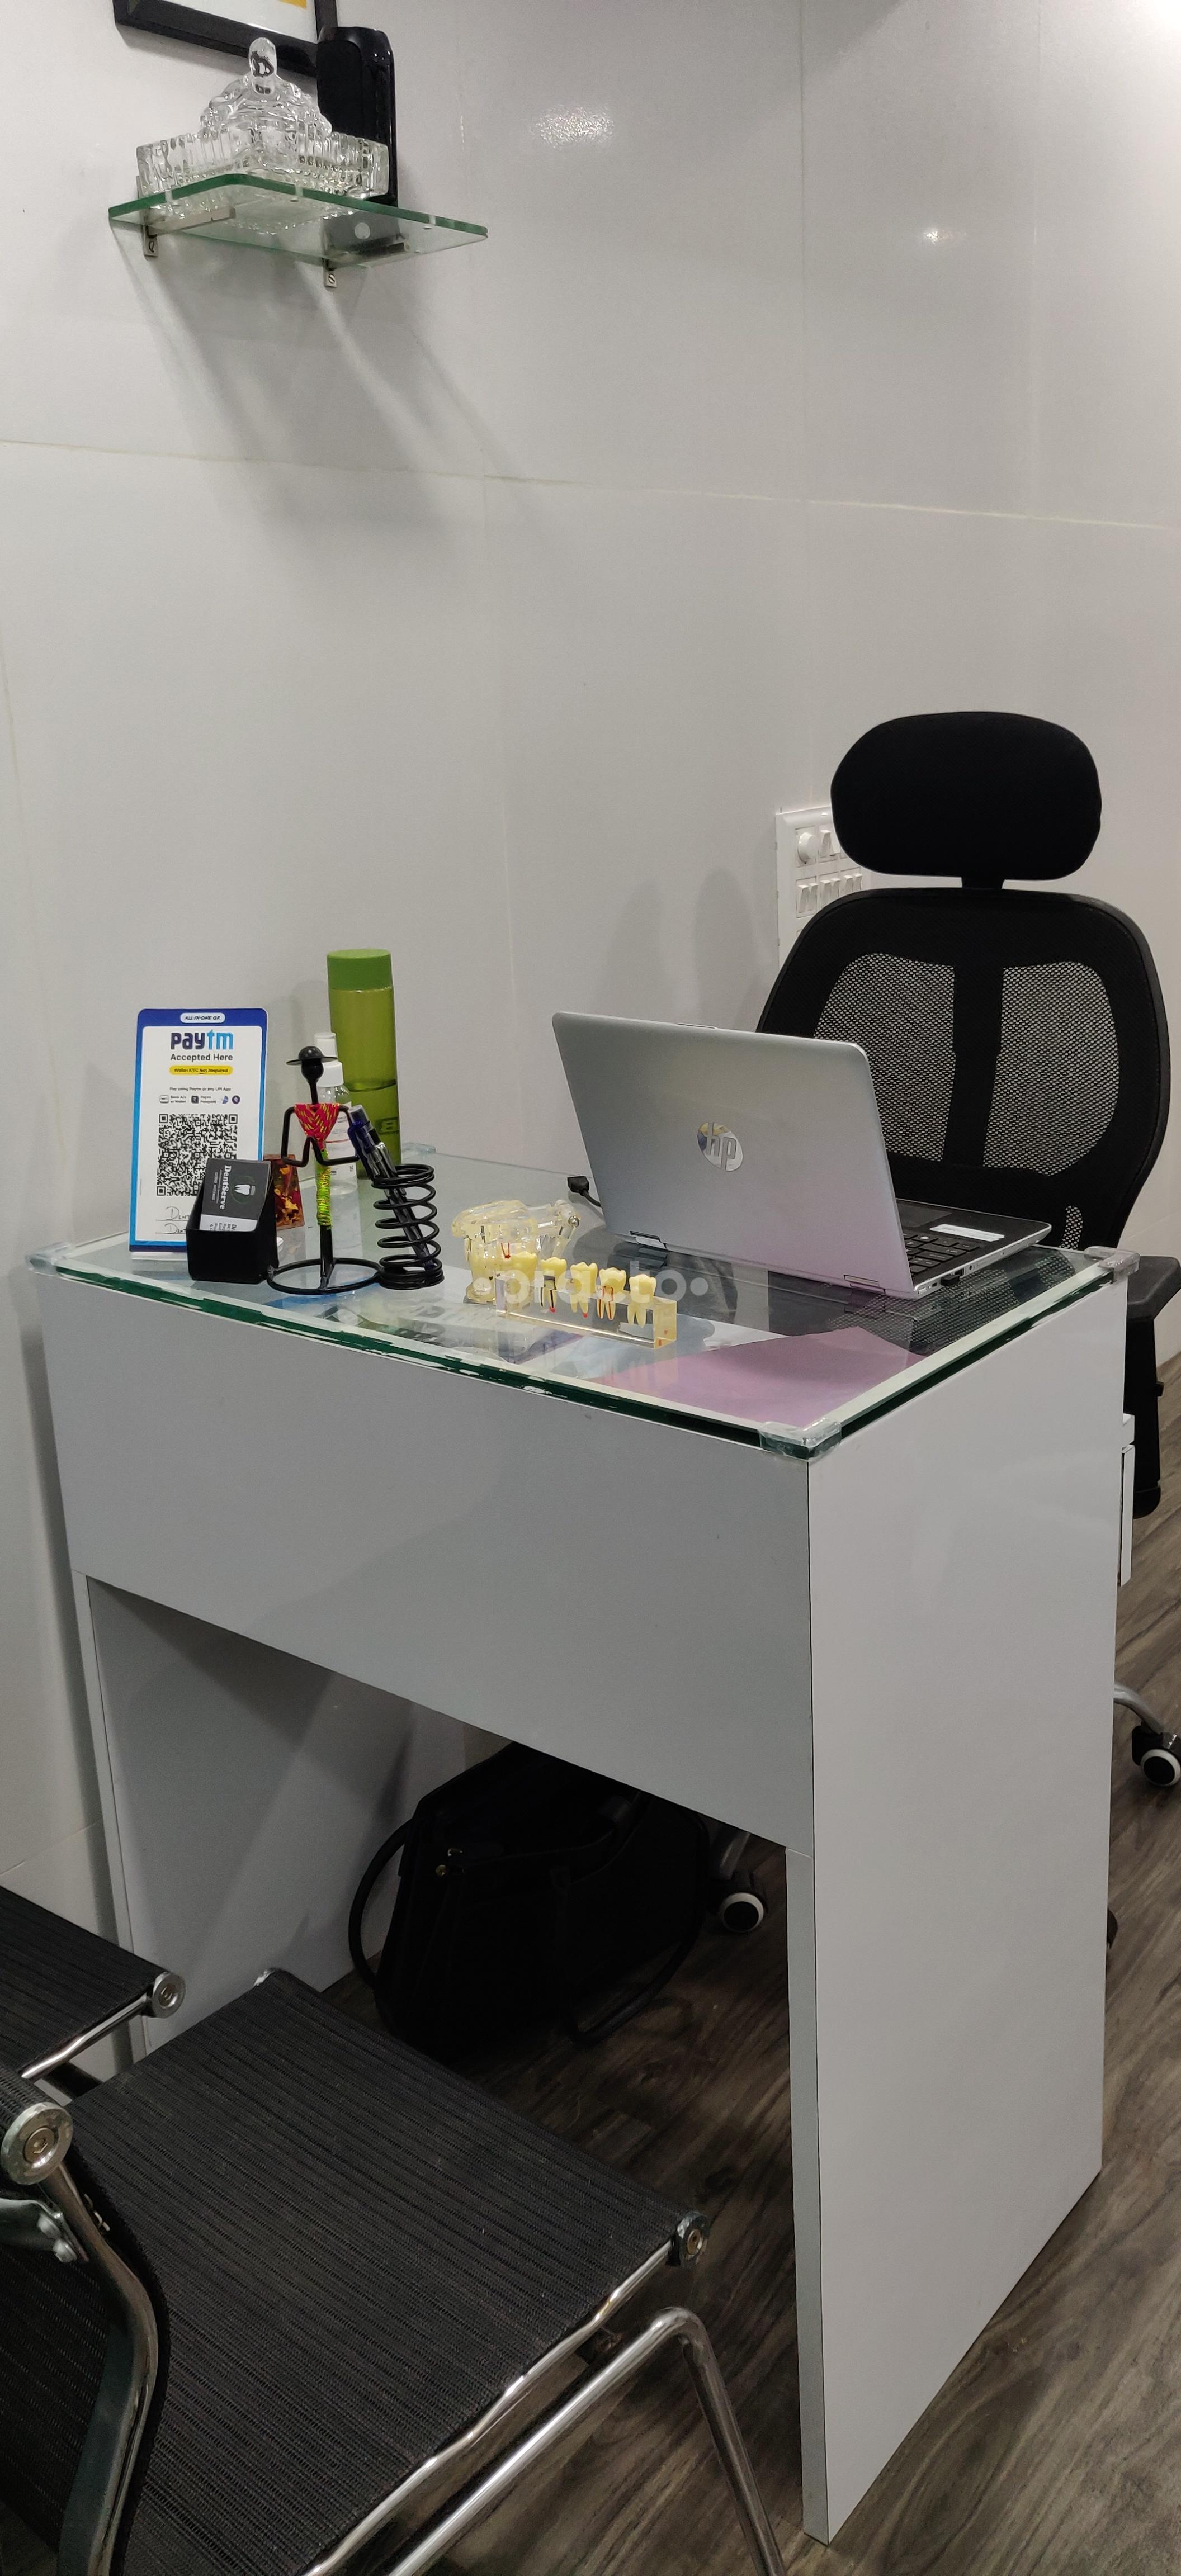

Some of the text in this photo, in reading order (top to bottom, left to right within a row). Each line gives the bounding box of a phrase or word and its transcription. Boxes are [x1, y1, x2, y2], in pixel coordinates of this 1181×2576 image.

[170, 1054, 211, 1062] Accepted
[705, 1122, 737, 1171] hp
[219, 1164, 232, 1210] DentServe
